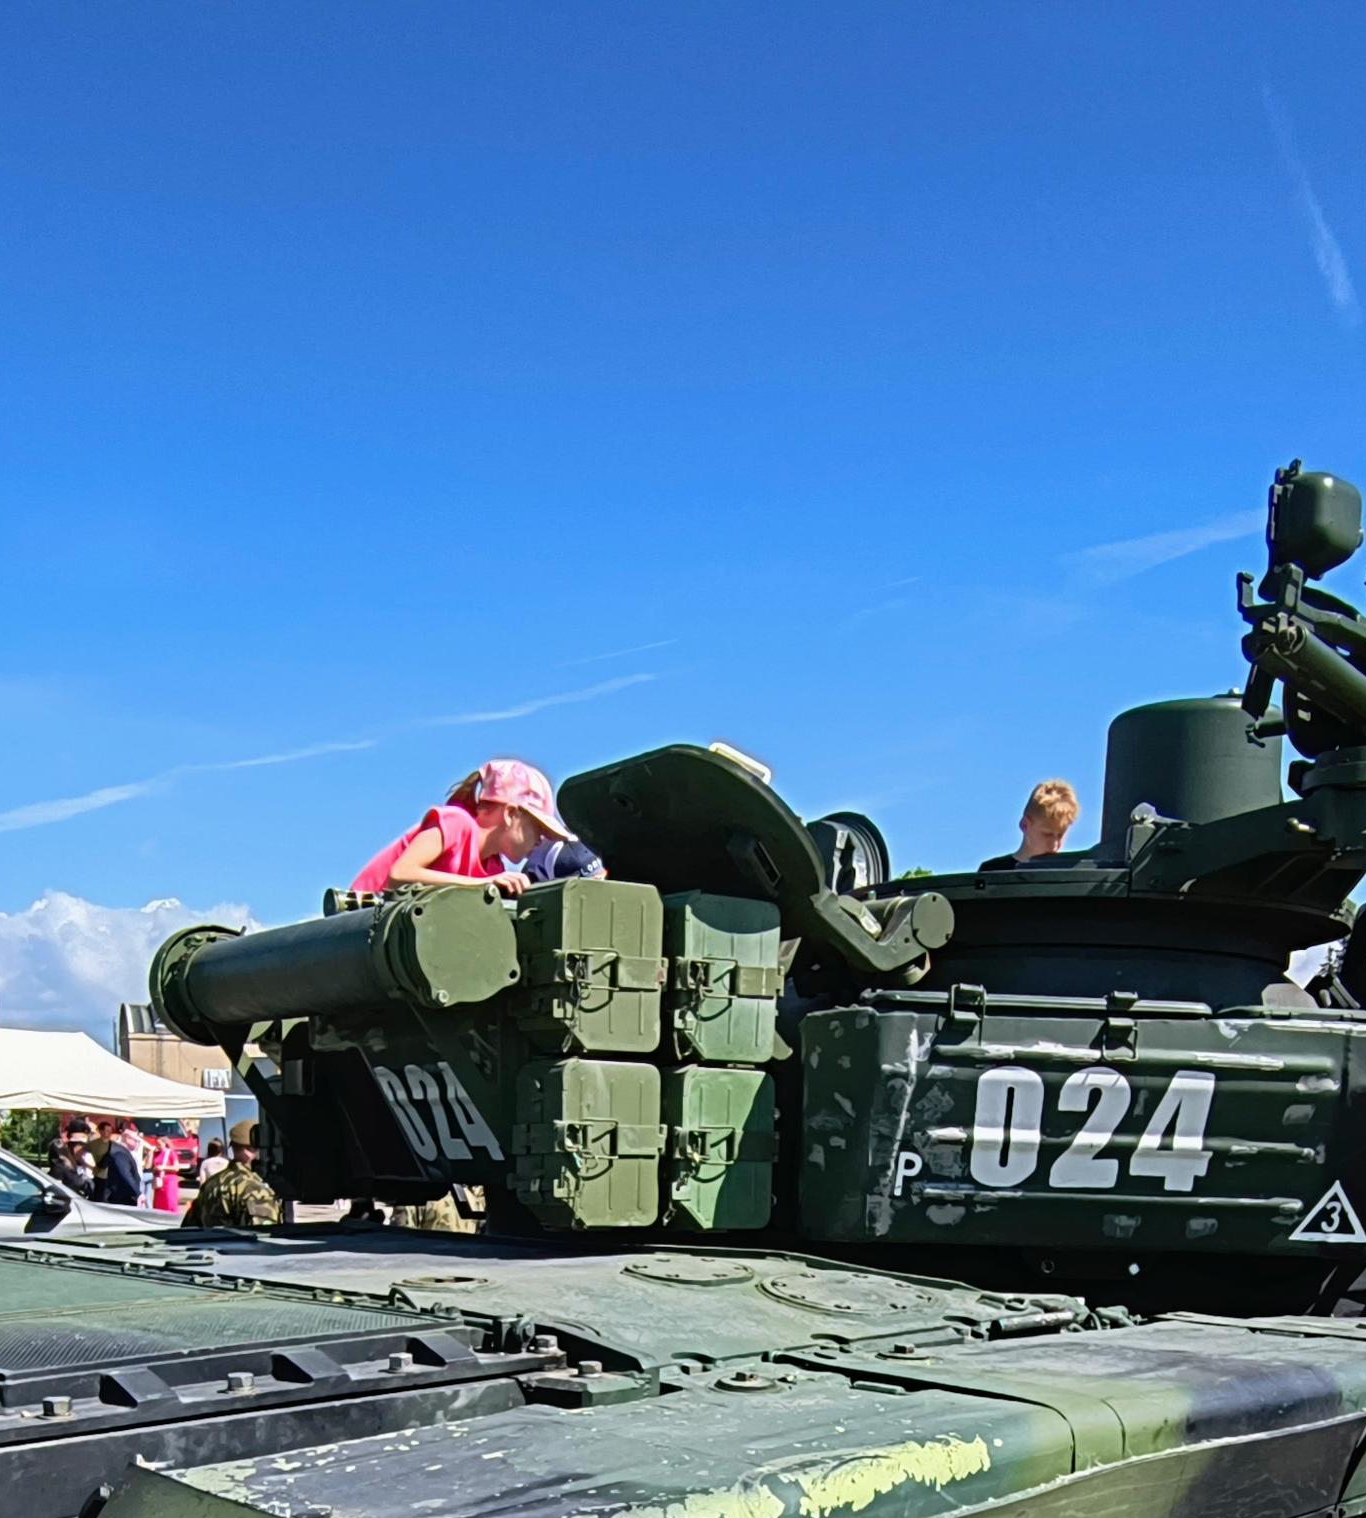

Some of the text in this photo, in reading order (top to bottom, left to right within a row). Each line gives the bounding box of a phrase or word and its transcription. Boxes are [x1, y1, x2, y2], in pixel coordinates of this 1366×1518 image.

[374, 1061, 505, 1161] 024
[970, 1066, 1215, 1192] 024
[893, 1152, 922, 1196] P
[1320, 1201, 1342, 1232] 3
